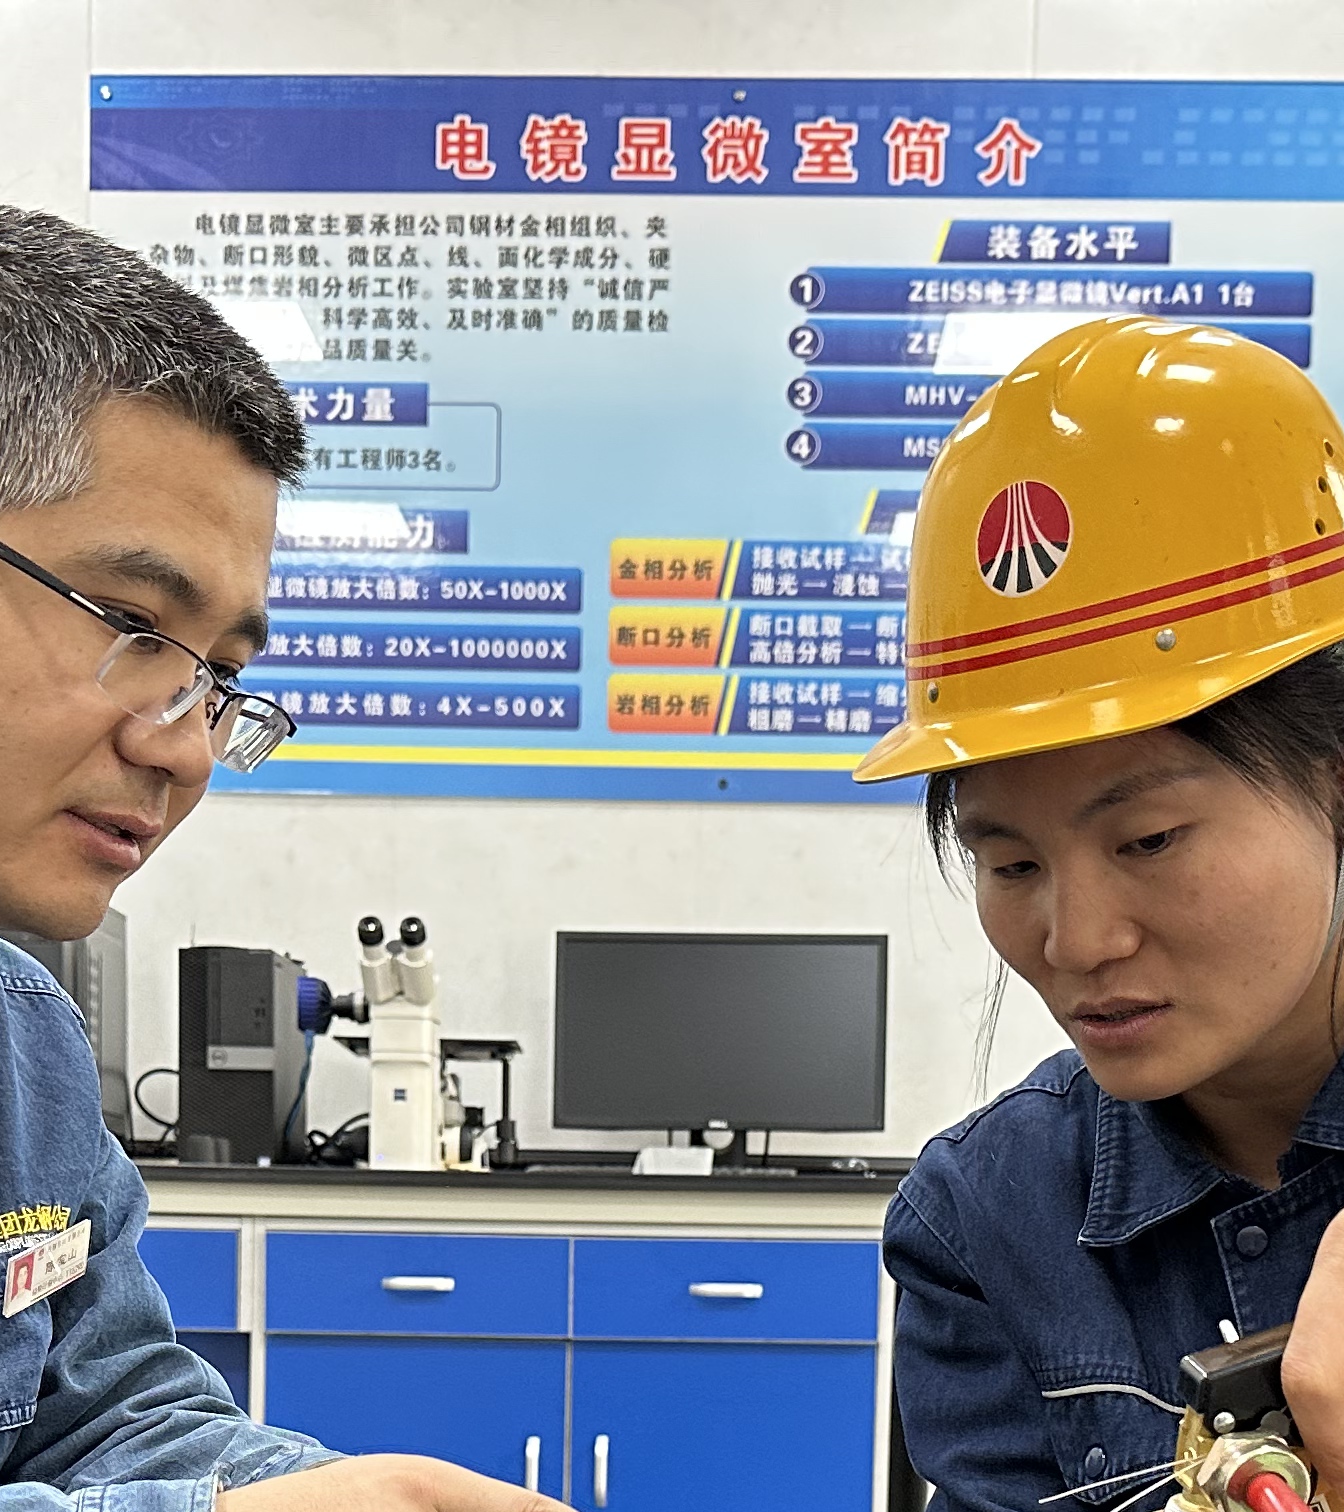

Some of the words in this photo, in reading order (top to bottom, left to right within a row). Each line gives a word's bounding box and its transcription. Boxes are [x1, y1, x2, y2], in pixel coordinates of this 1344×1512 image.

[436, 114, 1041, 184] 电镜显微室简介
[987, 224, 1140, 260] 装备水平
[1218, 281, 1255, 308] 1台
[618, 558, 714, 581] 金相分析
[616, 626, 712, 649] 断口分析
[749, 614, 906, 639] 断口截取—断
[749, 640, 906, 665] 高倍分析—特
[616, 693, 711, 716] 岩相分析
